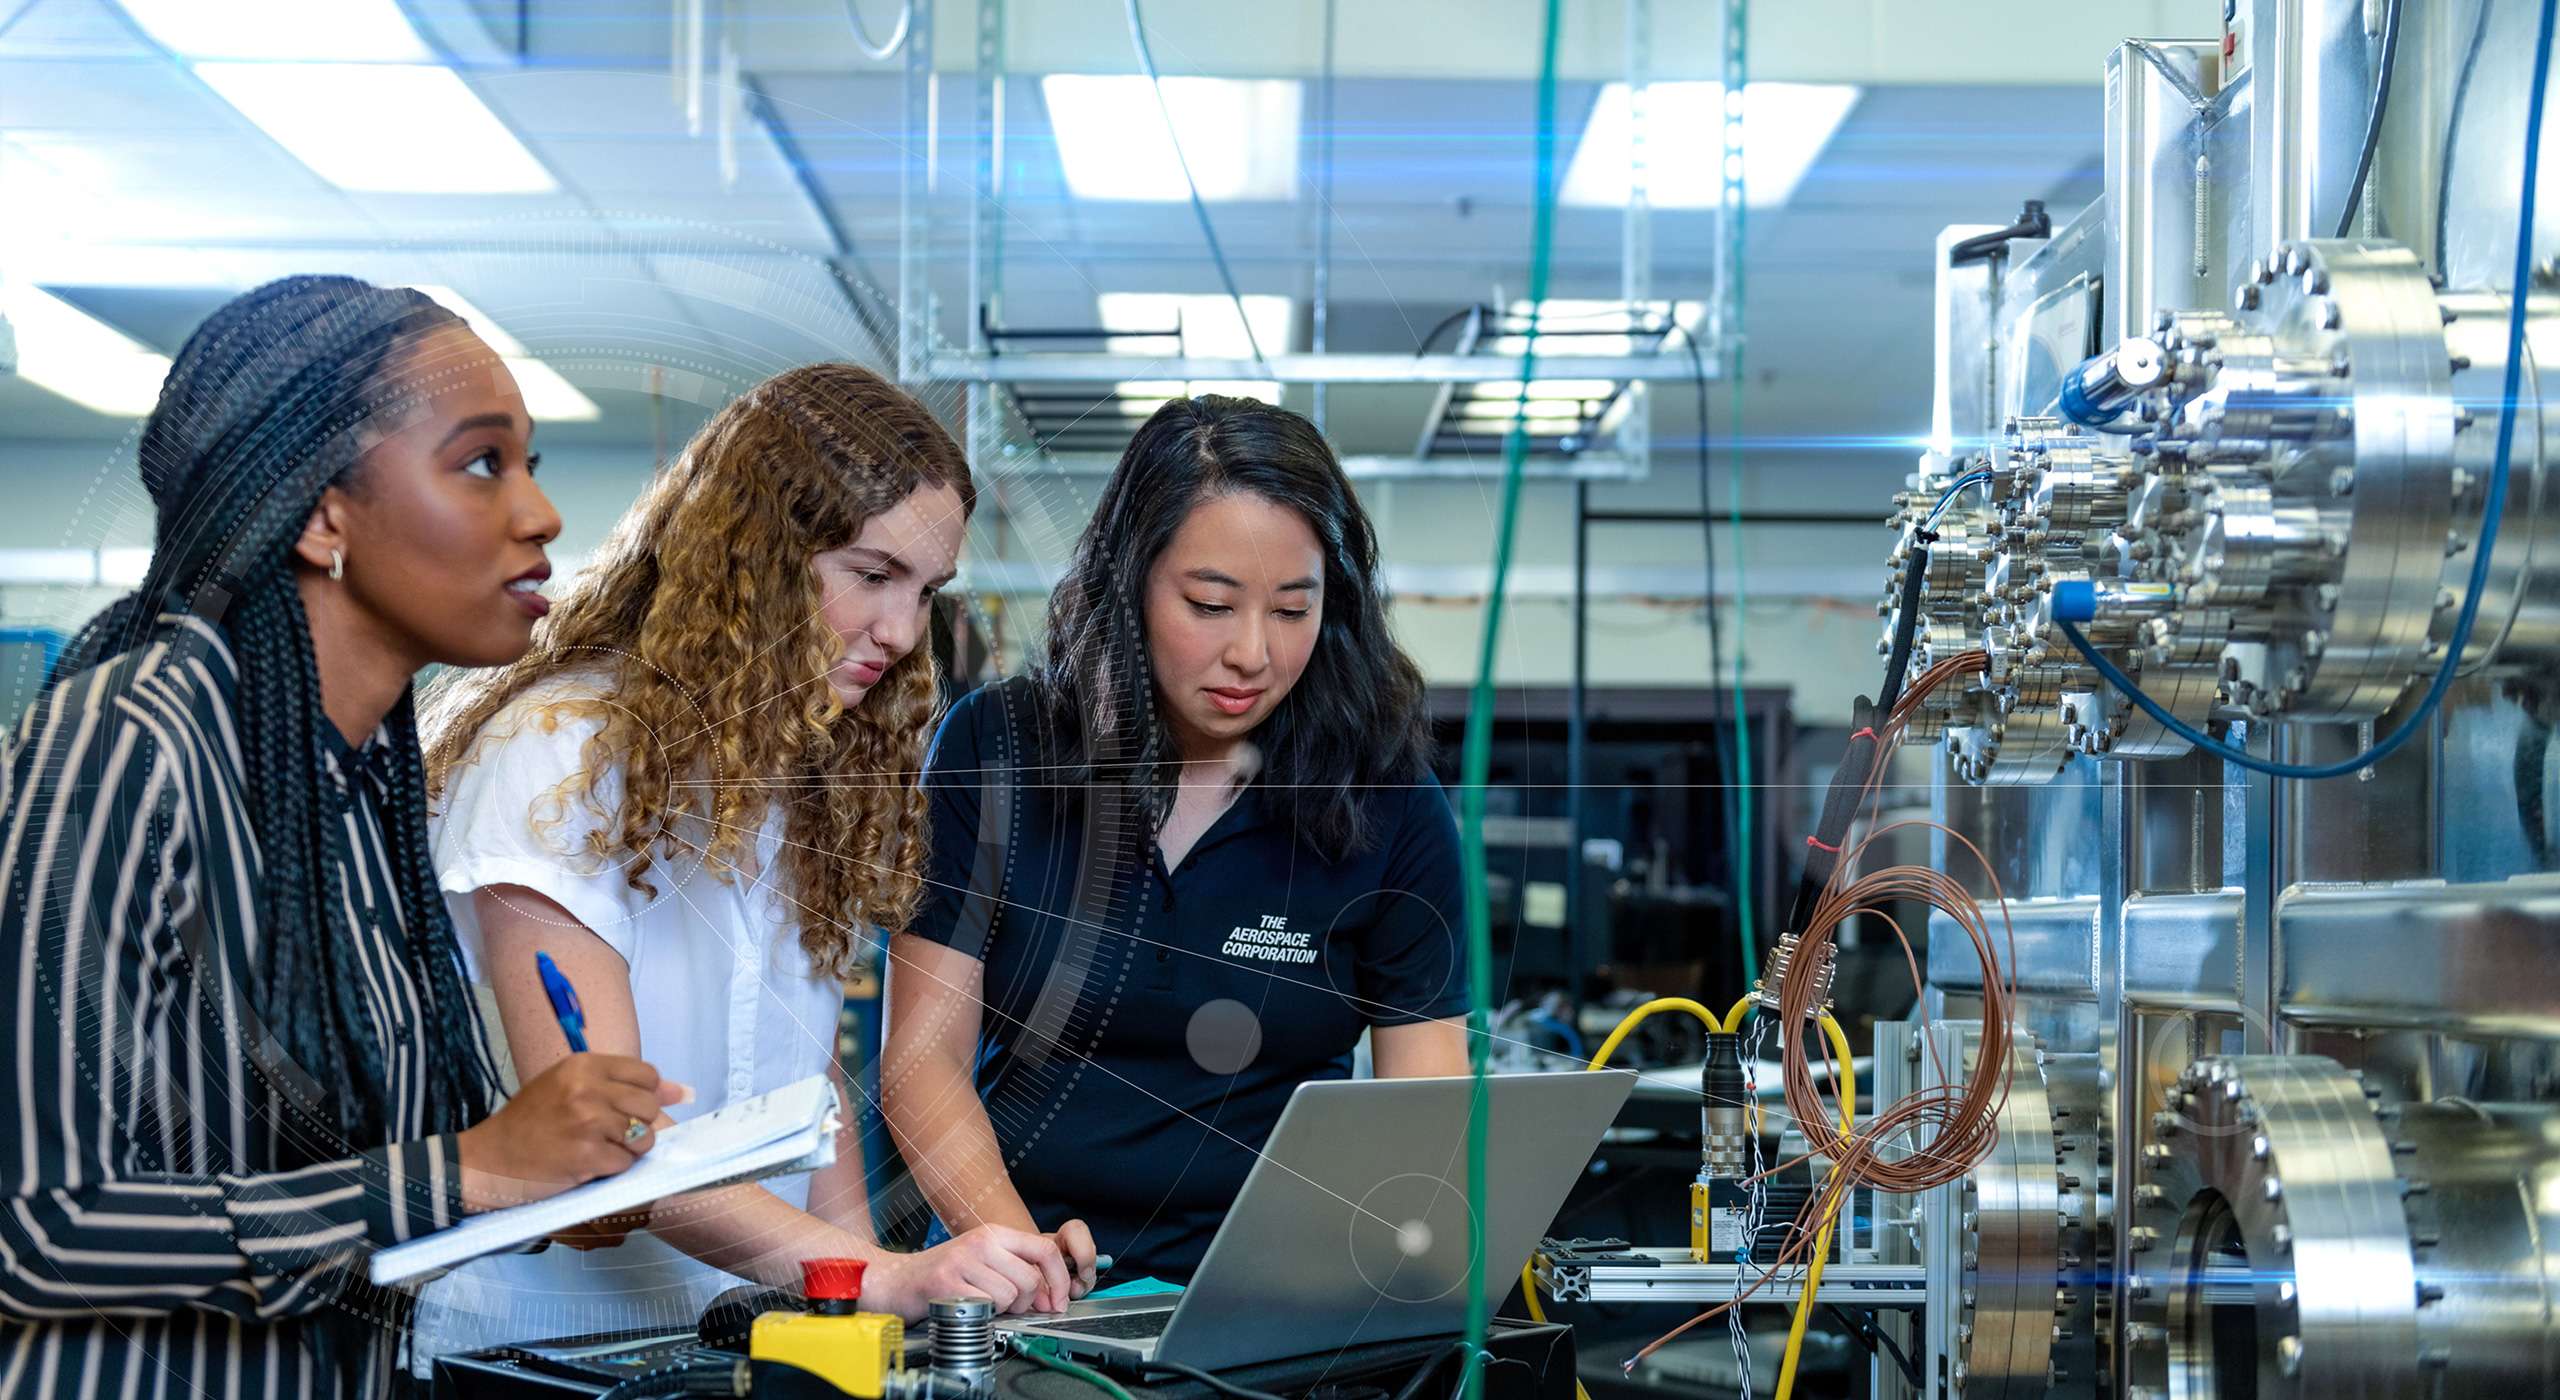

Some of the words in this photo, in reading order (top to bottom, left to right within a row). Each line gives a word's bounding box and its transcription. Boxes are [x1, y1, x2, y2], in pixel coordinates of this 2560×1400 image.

[1260, 915, 1287, 930] THE
[1229, 927, 1311, 947] AEROSPACE
[1222, 941, 1317, 964] CORPORATION
